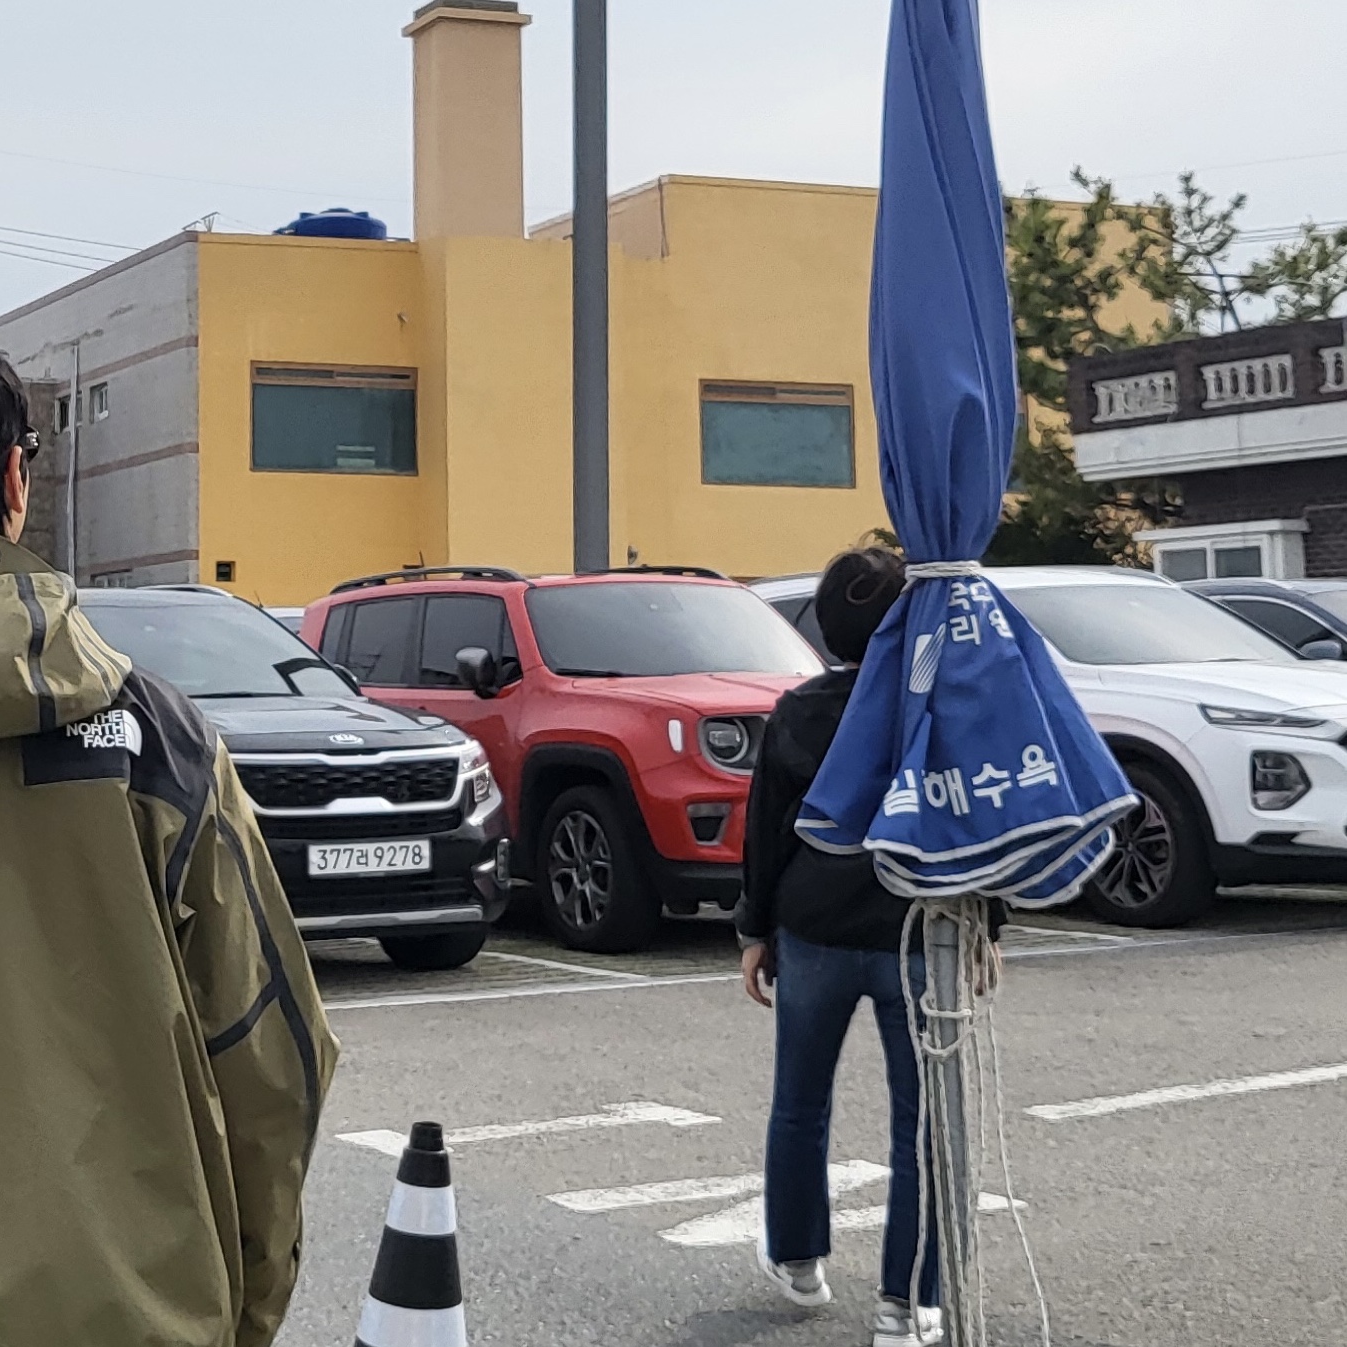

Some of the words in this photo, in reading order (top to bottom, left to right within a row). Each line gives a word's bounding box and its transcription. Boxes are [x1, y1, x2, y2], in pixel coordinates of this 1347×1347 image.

[94, 709, 123, 724] THE
[66, 721, 124, 737] NORTH
[83, 734, 126, 748] FACE
